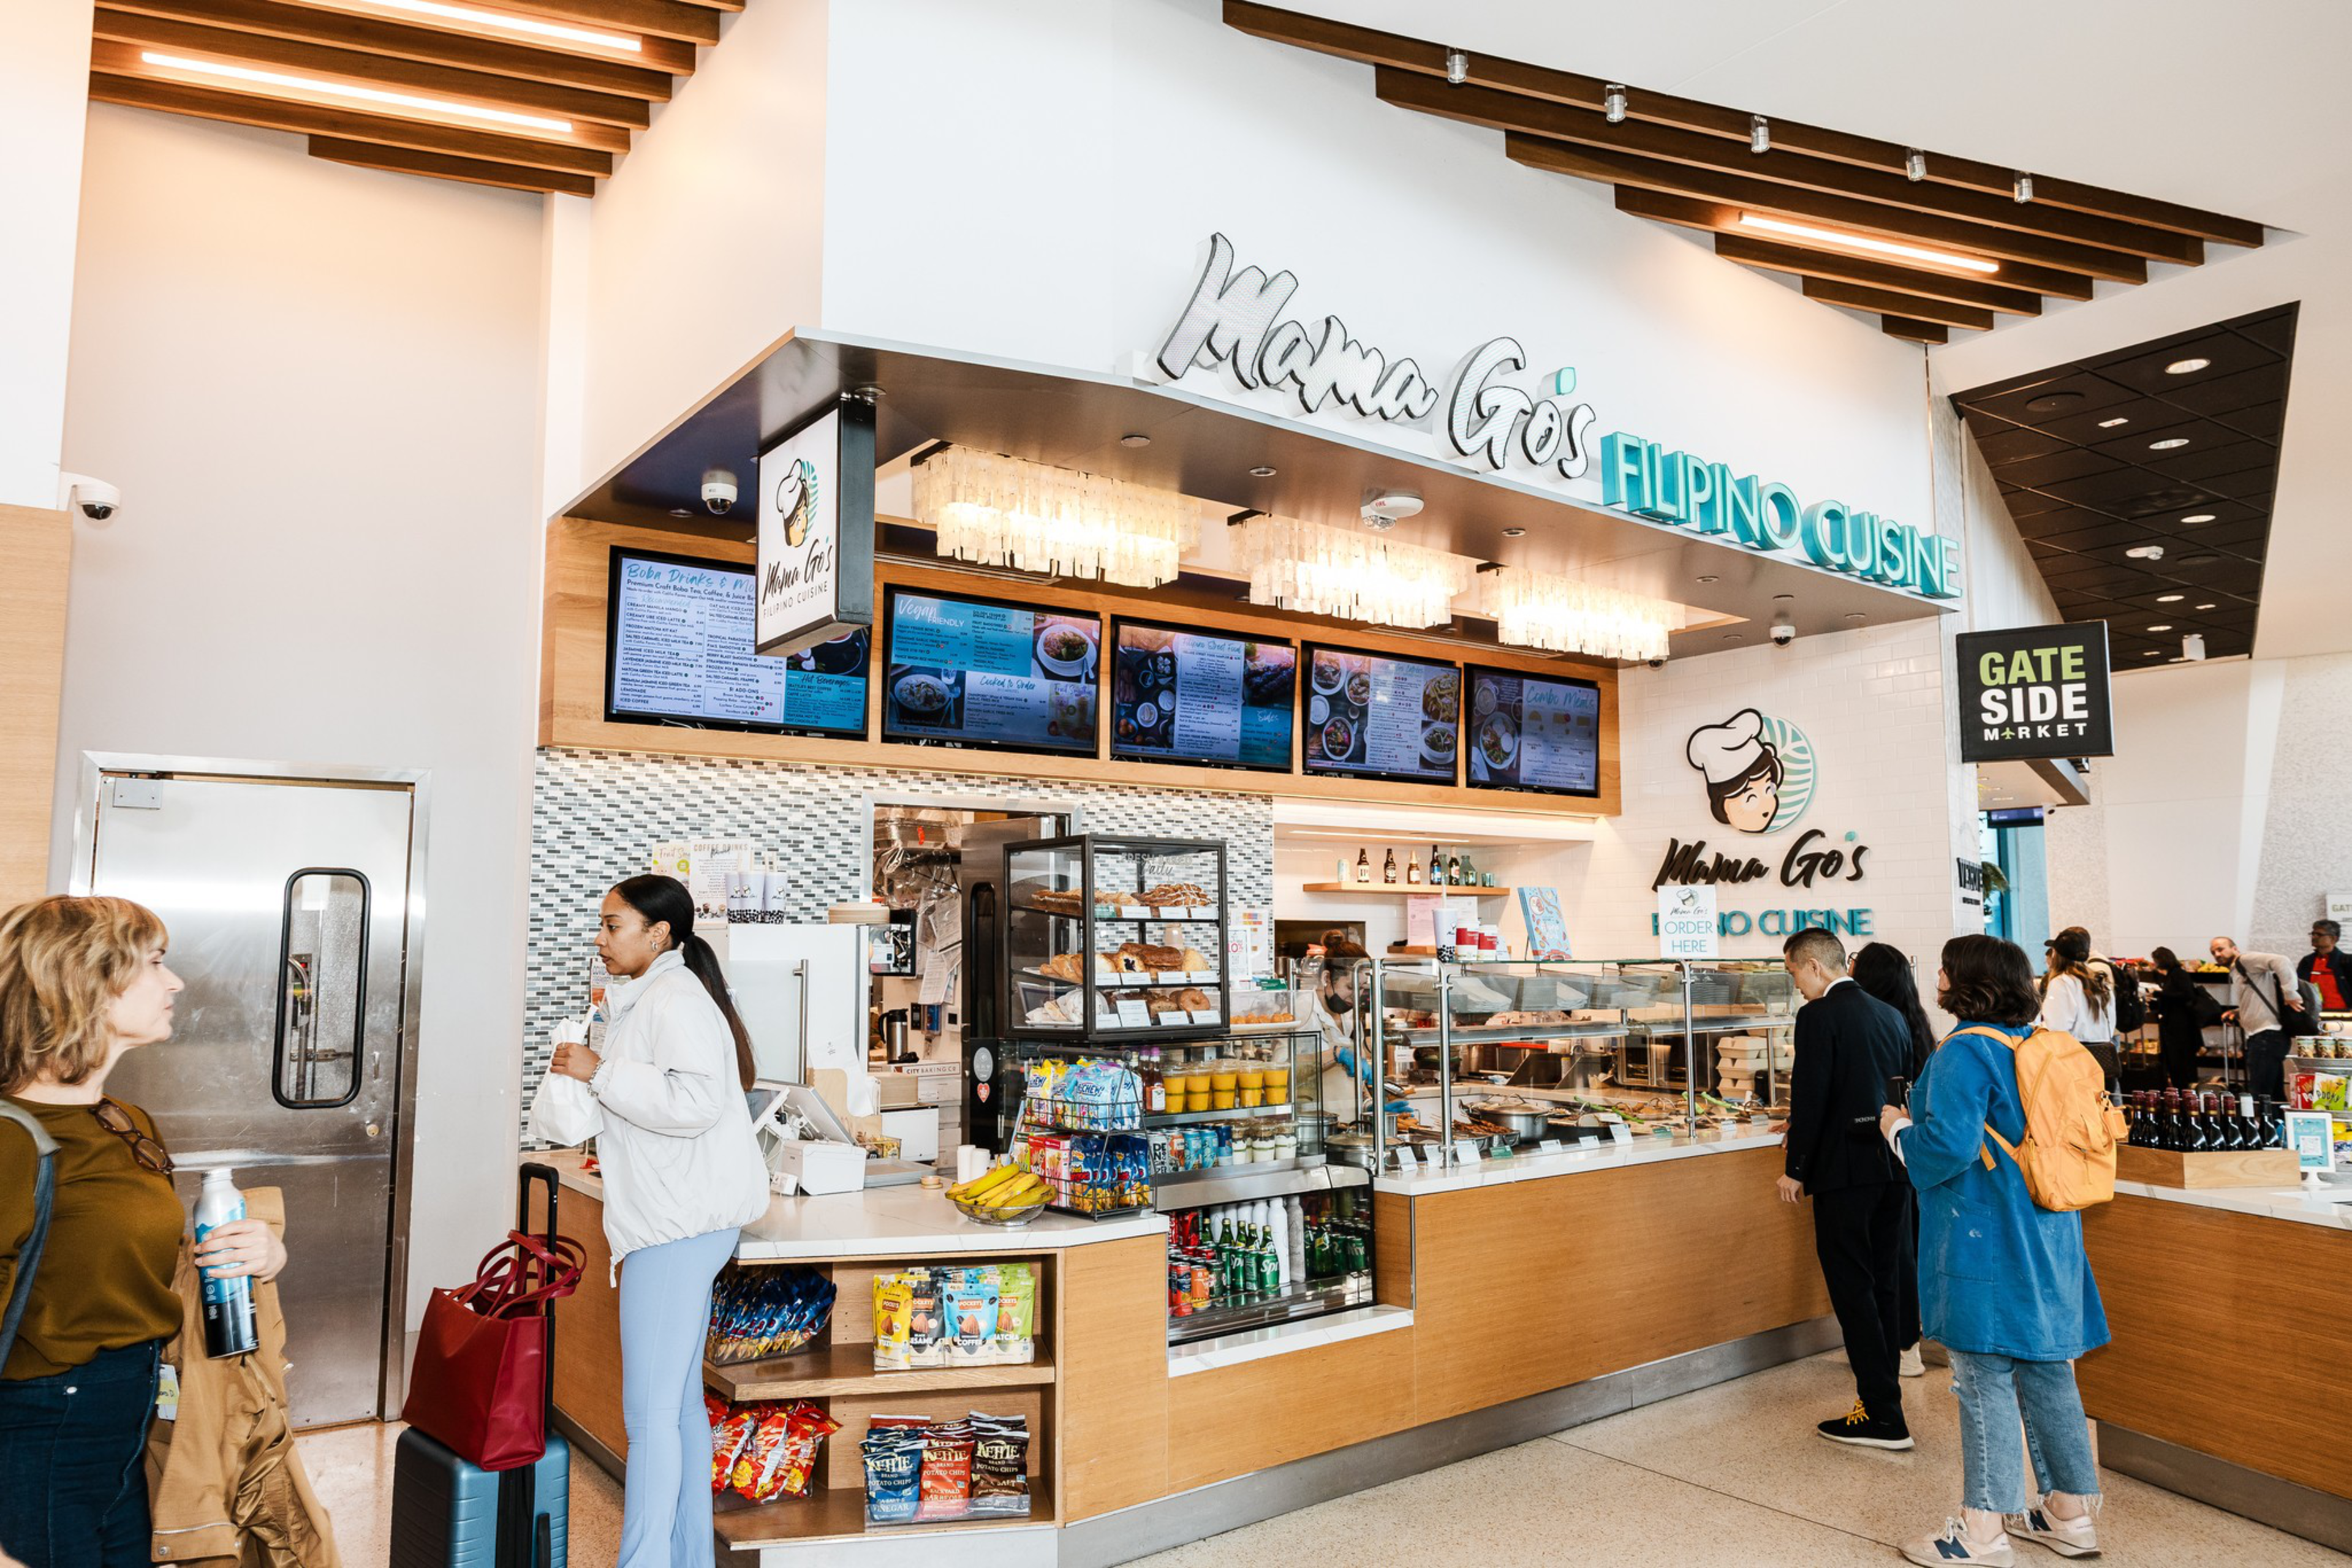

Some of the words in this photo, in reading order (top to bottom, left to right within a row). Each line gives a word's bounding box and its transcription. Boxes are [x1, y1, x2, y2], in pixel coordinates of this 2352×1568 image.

[1157, 232, 1439, 420] Mama
[1601, 431, 1802, 550] FILIPINO
[1801, 500, 1963, 600] CUISINE
[626, 564, 661, 579] Boba
[668, 569, 714, 587] Drinks
[720, 577, 727, 588] &
[762, 561, 800, 605] Mama
[763, 597, 793, 619] FILIPINO
[797, 581, 828, 604] CUISINE
[899, 598, 937, 620] Vegan
[928, 617, 964, 627] FRIENDLY
[1980, 645, 2085, 687] GATE
[801, 674, 814, 683] Hot
[1526, 686, 1559, 705] Combo
[1980, 682, 2089, 725] SIDE
[1984, 723, 2087, 741] MRKET
[1121, 853, 1156, 864] FRESH
[1652, 837, 1769, 893] Mama
[1665, 921, 1713, 934] ORDER
[1758, 908, 1874, 937] CUISINE
[1671, 940, 1707, 953] HERE
[922, 1447, 969, 1461] KETTLE
[975, 1440, 1019, 1460] KETTLE
[865, 1452, 913, 1472] KETTLE
[976, 1463, 999, 1472] POTATO
